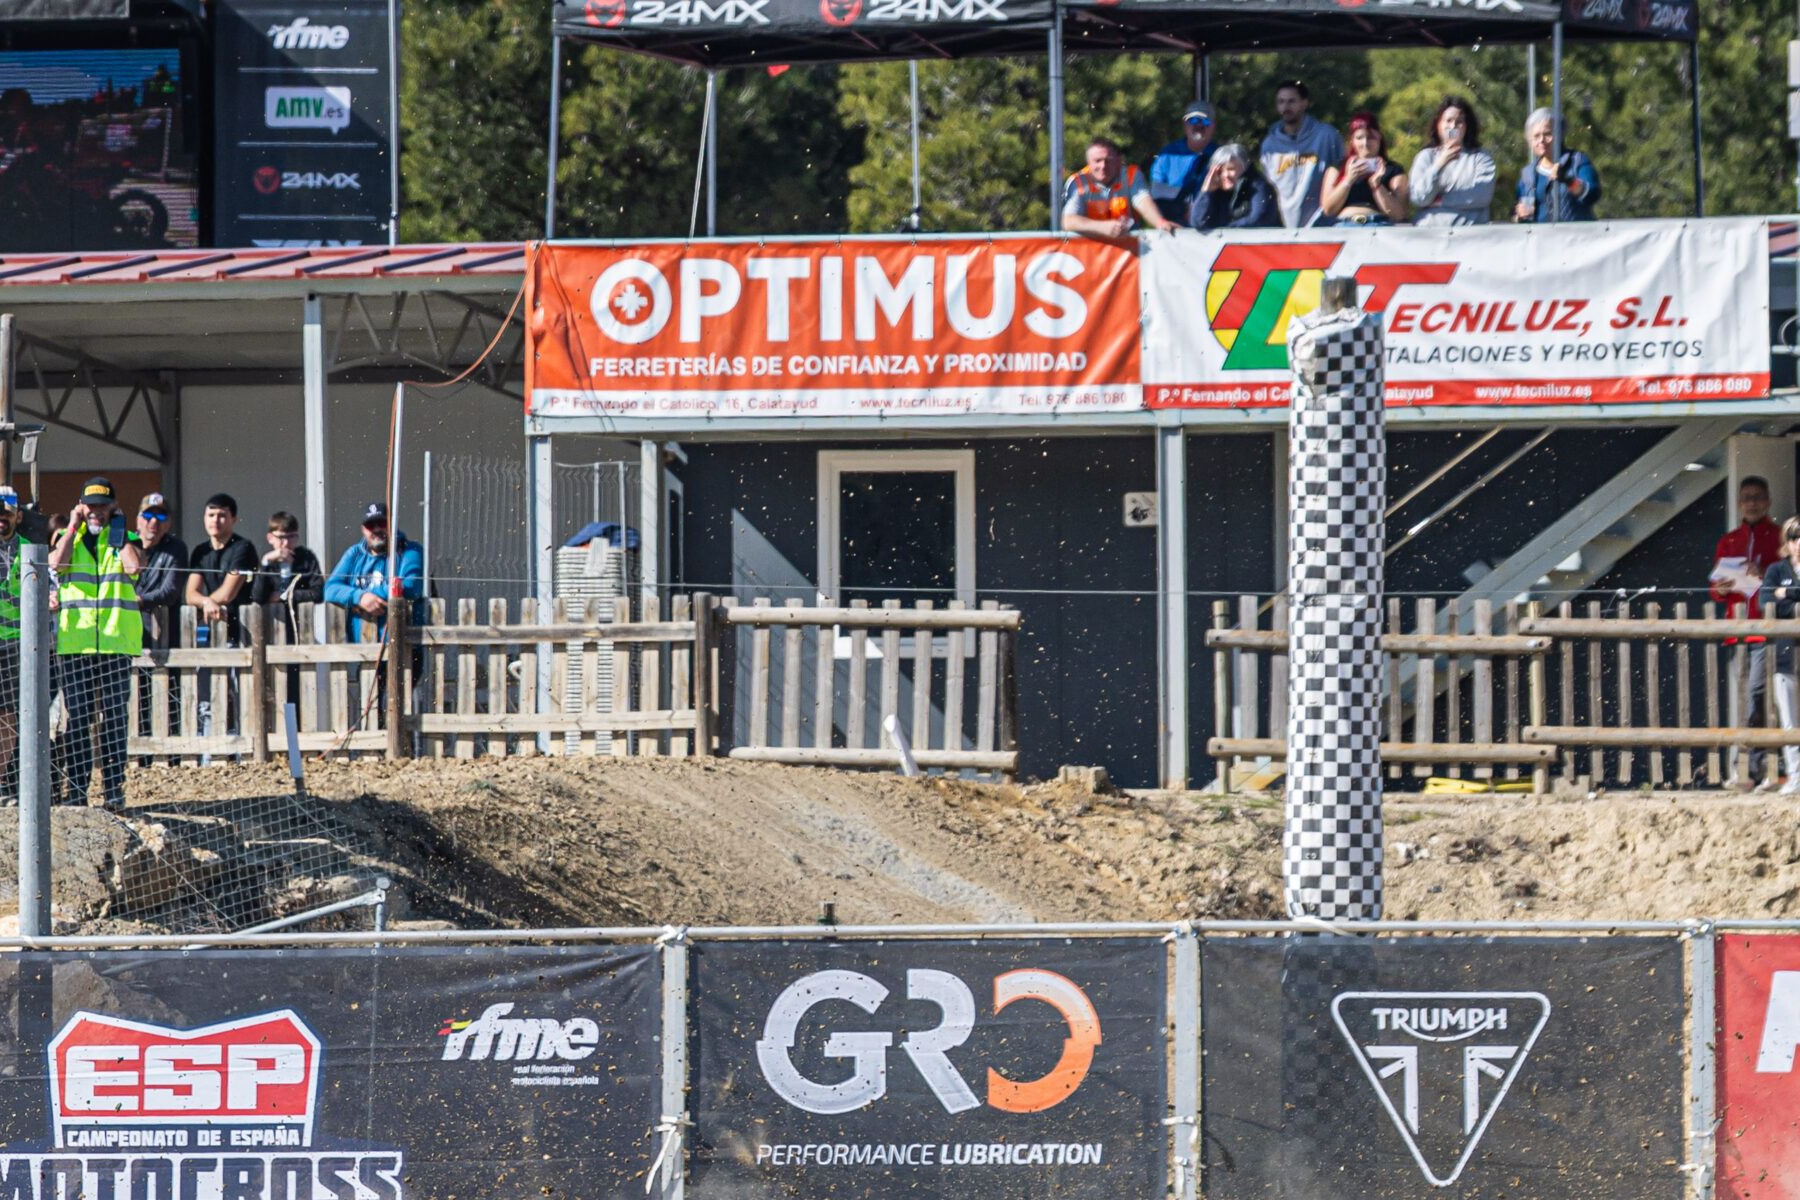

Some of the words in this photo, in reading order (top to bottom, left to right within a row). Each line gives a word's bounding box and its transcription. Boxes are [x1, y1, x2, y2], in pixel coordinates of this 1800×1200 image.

[630, 0, 770, 24] 24MX
[867, 0, 1009, 20] 24MX
[267, 18, 349, 49] rfme
[281, 172, 361, 190] 24MX
[591, 251, 1089, 345] OPTIMUS
[1609, 295, 1689, 331] S.L.
[1542, 345, 1557, 362] Y
[1561, 339, 1704, 361] PROYECTOS
[590, 353, 747, 377] FERRETERÍAS
[753, 355, 783, 377] DE
[787, 354, 919, 376] CONFIANZA
[923, 354, 939, 375] Y
[944, 350, 1088, 374] PROXIMIDAD
[1183, 387, 1250, 402] Fernando
[1254, 387, 1268, 401] el
[1475, 383, 1592, 400] www.tecniluz.es
[1637, 379, 1662, 394] Tel.
[1668, 378, 1692, 394] 976
[1726, 377, 1752, 393] 080
[642, 397, 655, 411] el
[748, 396, 819, 411] Calatayud
[441, 1002, 600, 1061] rfme
[1371, 1007, 1508, 1035] TRIUMPH
[65, 1044, 306, 1111] ESP
[66, 1129, 189, 1148] CAMPEONATO
[197, 1129, 223, 1147] DE
[230, 1125, 300, 1147] ESPAÑA
[757, 1143, 935, 1166] PERFORMANCE
[941, 1143, 1103, 1166] LUBRICATION
